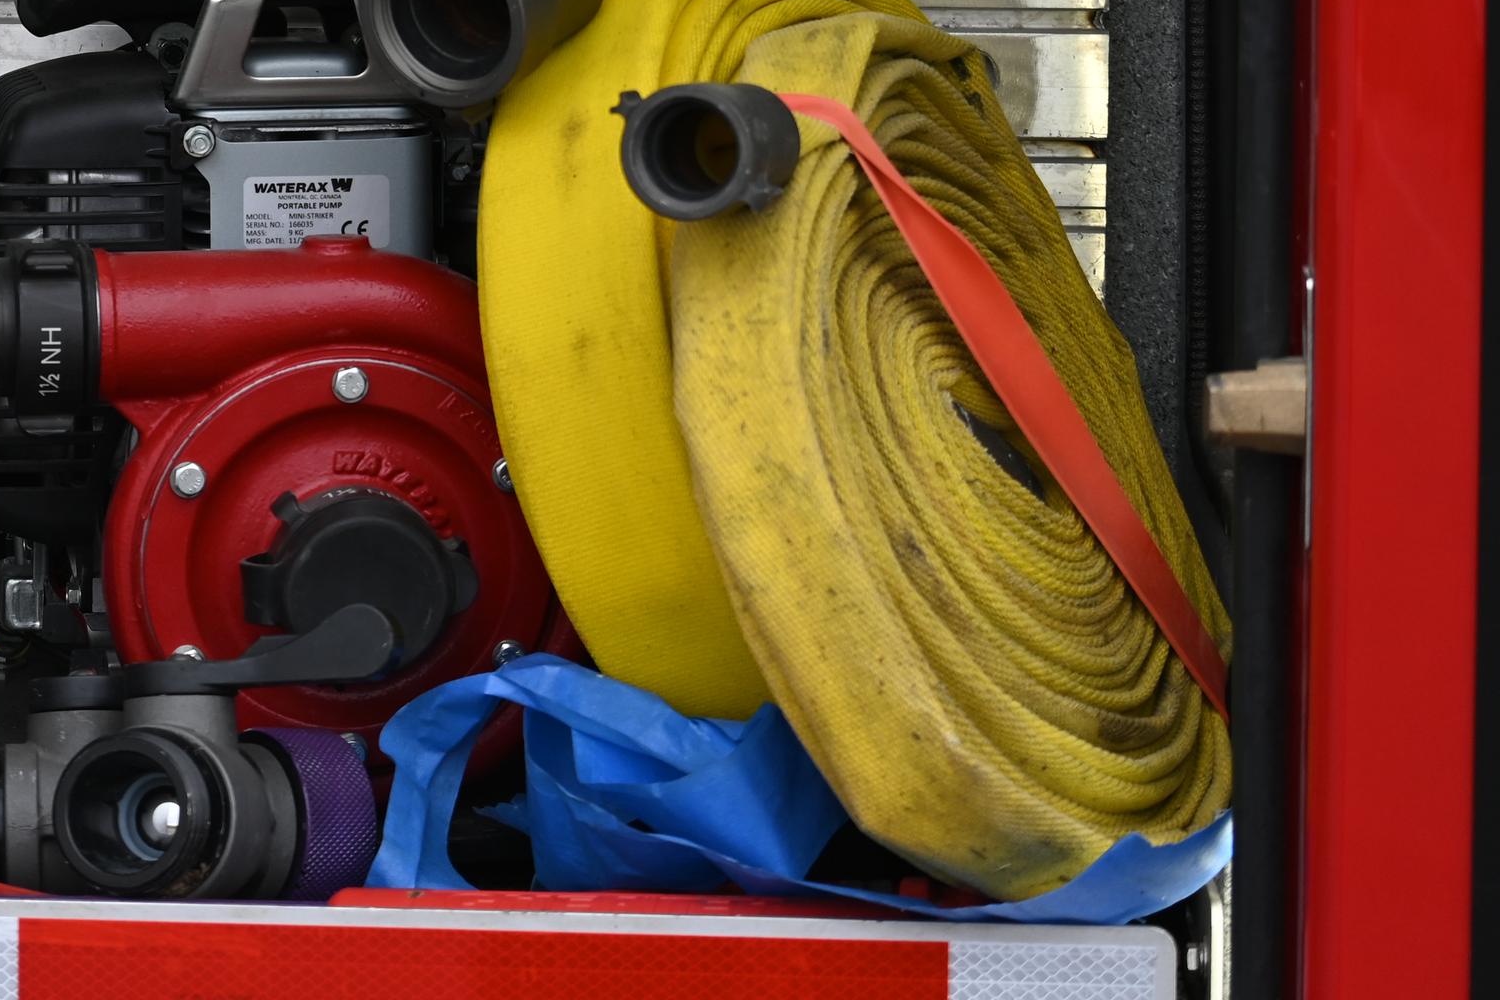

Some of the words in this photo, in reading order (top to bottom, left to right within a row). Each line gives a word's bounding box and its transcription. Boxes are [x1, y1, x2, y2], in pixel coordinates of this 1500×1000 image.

[254, 182, 328, 193] WATERAX
[288, 212, 334, 220] MINI-STRIKER
[289, 220, 314, 228] 166035
[40, 327, 62, 364] NH
